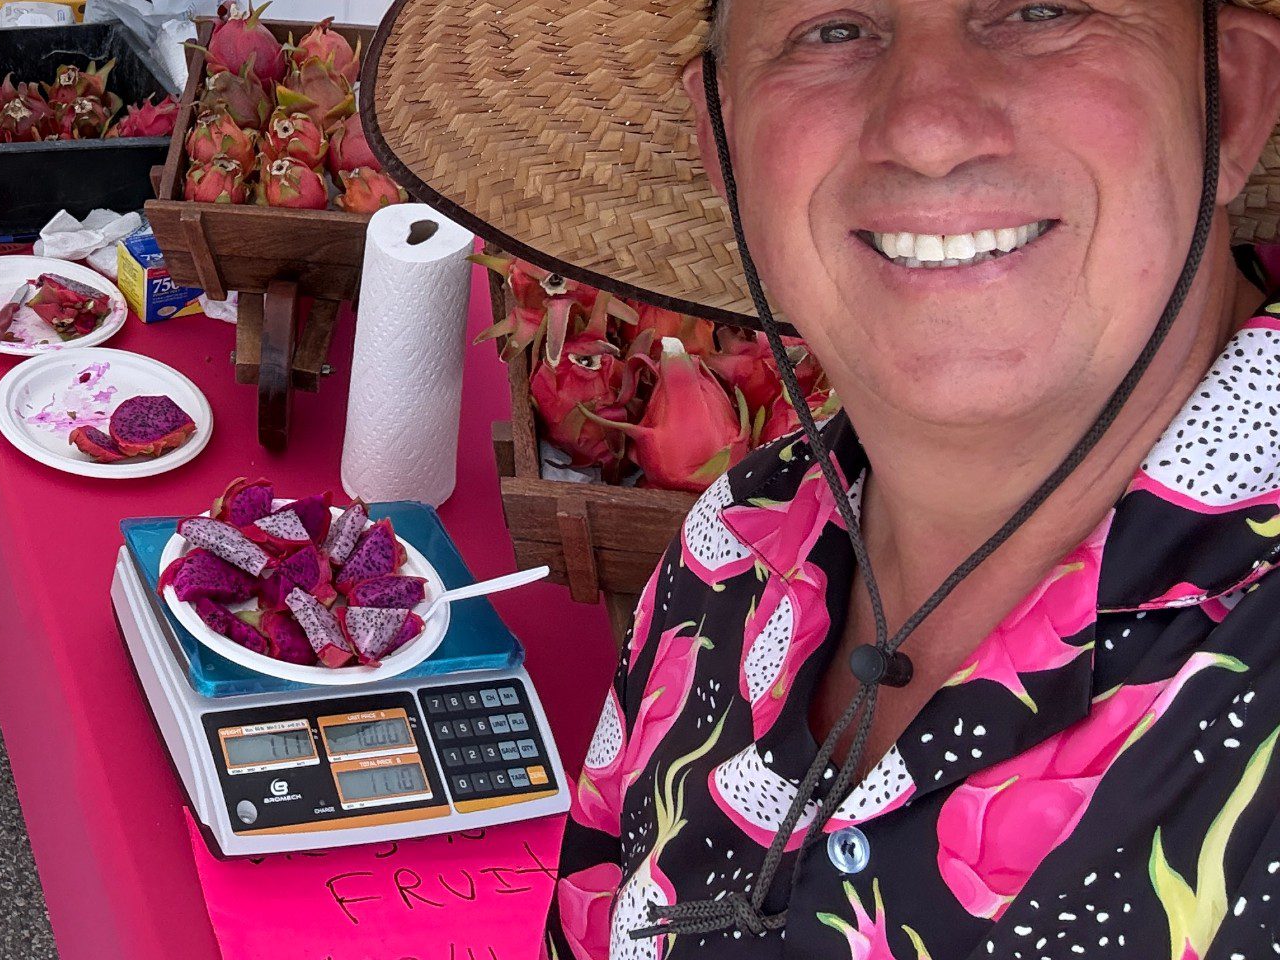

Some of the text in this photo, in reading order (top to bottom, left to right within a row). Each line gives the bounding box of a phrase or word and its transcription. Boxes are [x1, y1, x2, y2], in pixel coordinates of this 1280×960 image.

[432, 699, 439, 708] 7
[450, 697, 459, 707] 8
[468, 695, 477, 705] 9
[441, 725, 449, 735] 4
[459, 723, 467, 733] 5
[477, 721, 486, 731] 6
[450, 752, 457, 761] 1
[468, 749, 477, 759] 2
[487, 748, 495, 757] 3
[359, 760, 377, 768] TOTAL
[378, 758, 393, 766] PRICE
[459, 779, 467, 788] 0
[496, 774, 505, 784] C
[263, 793, 302, 804] BROMECH
[314, 806, 336, 815] CHARGE
